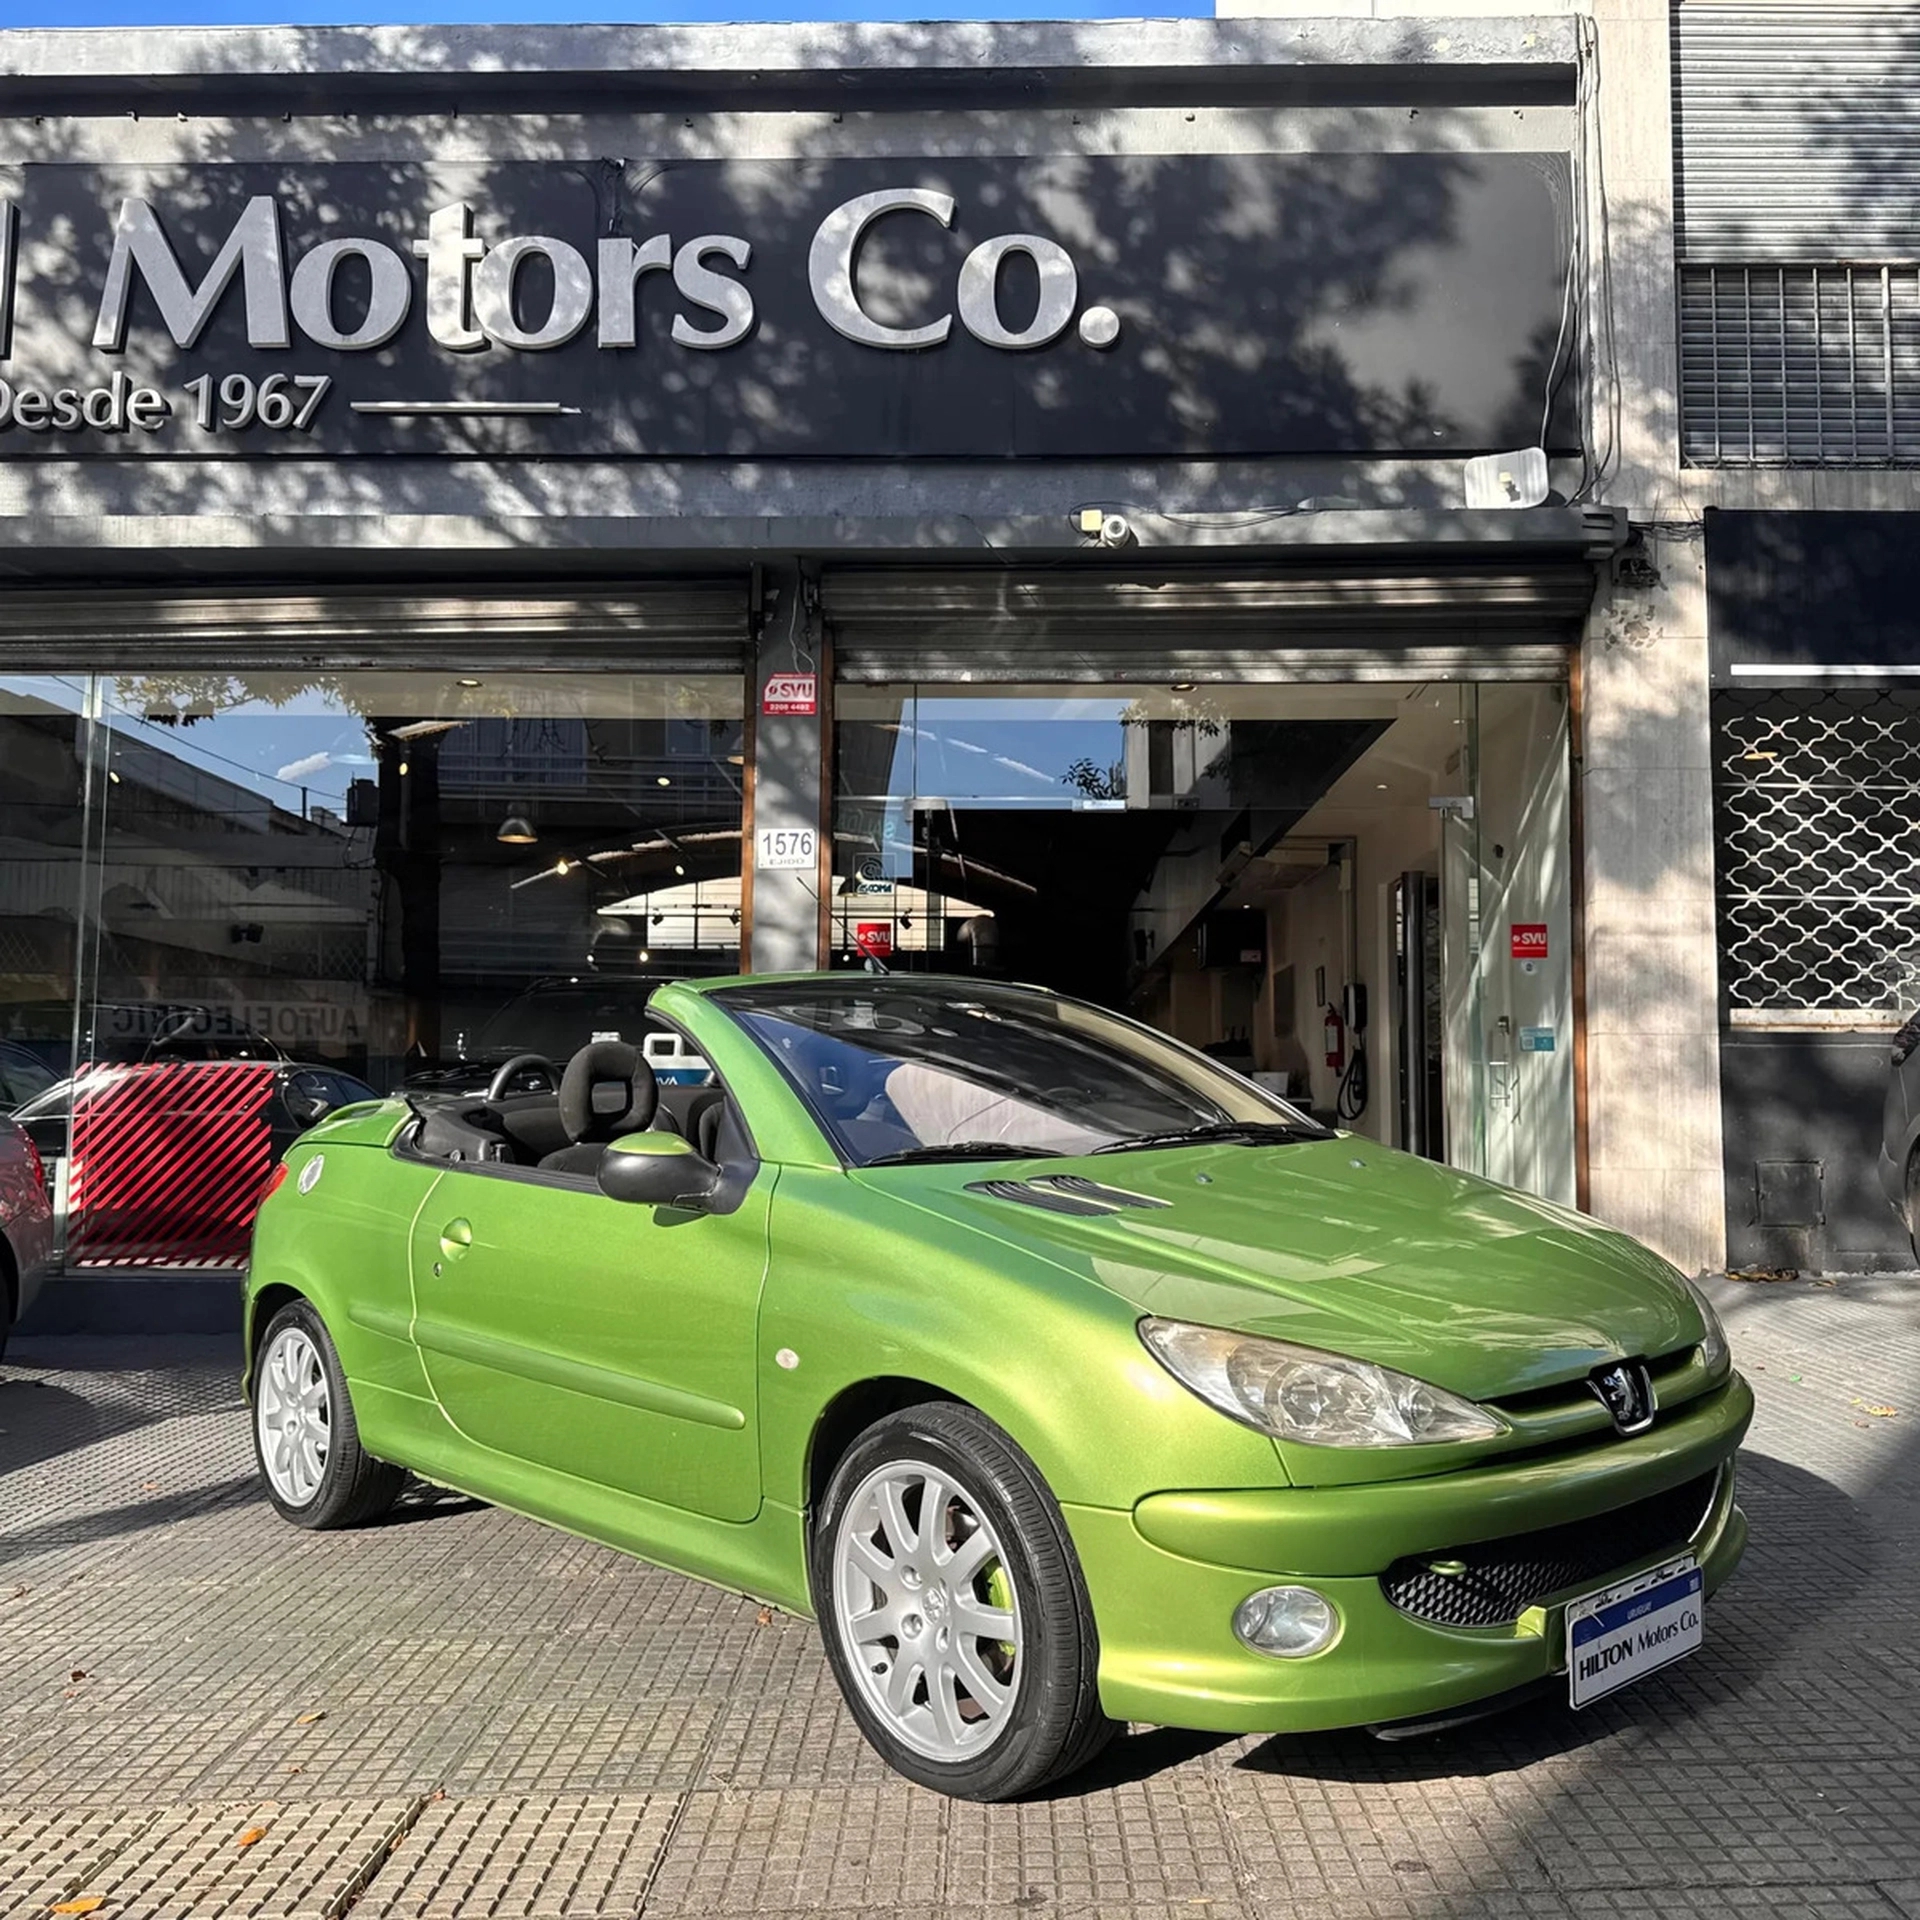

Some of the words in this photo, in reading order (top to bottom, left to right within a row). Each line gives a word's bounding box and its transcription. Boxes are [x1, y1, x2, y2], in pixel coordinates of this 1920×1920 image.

[92, 194, 755, 351] Motors
[808, 187, 1120, 349] Co.
[183, 373, 331, 431] 1967
[780, 682, 813, 698] SVU
[762, 832, 812, 856] 1576
[867, 930, 890, 943] SVU
[1521, 932, 1547, 945] SVU
[1579, 1637, 1633, 1681] HILTON
[1637, 1621, 1680, 1654] Motors
[1680, 1610, 1699, 1632] Co.
